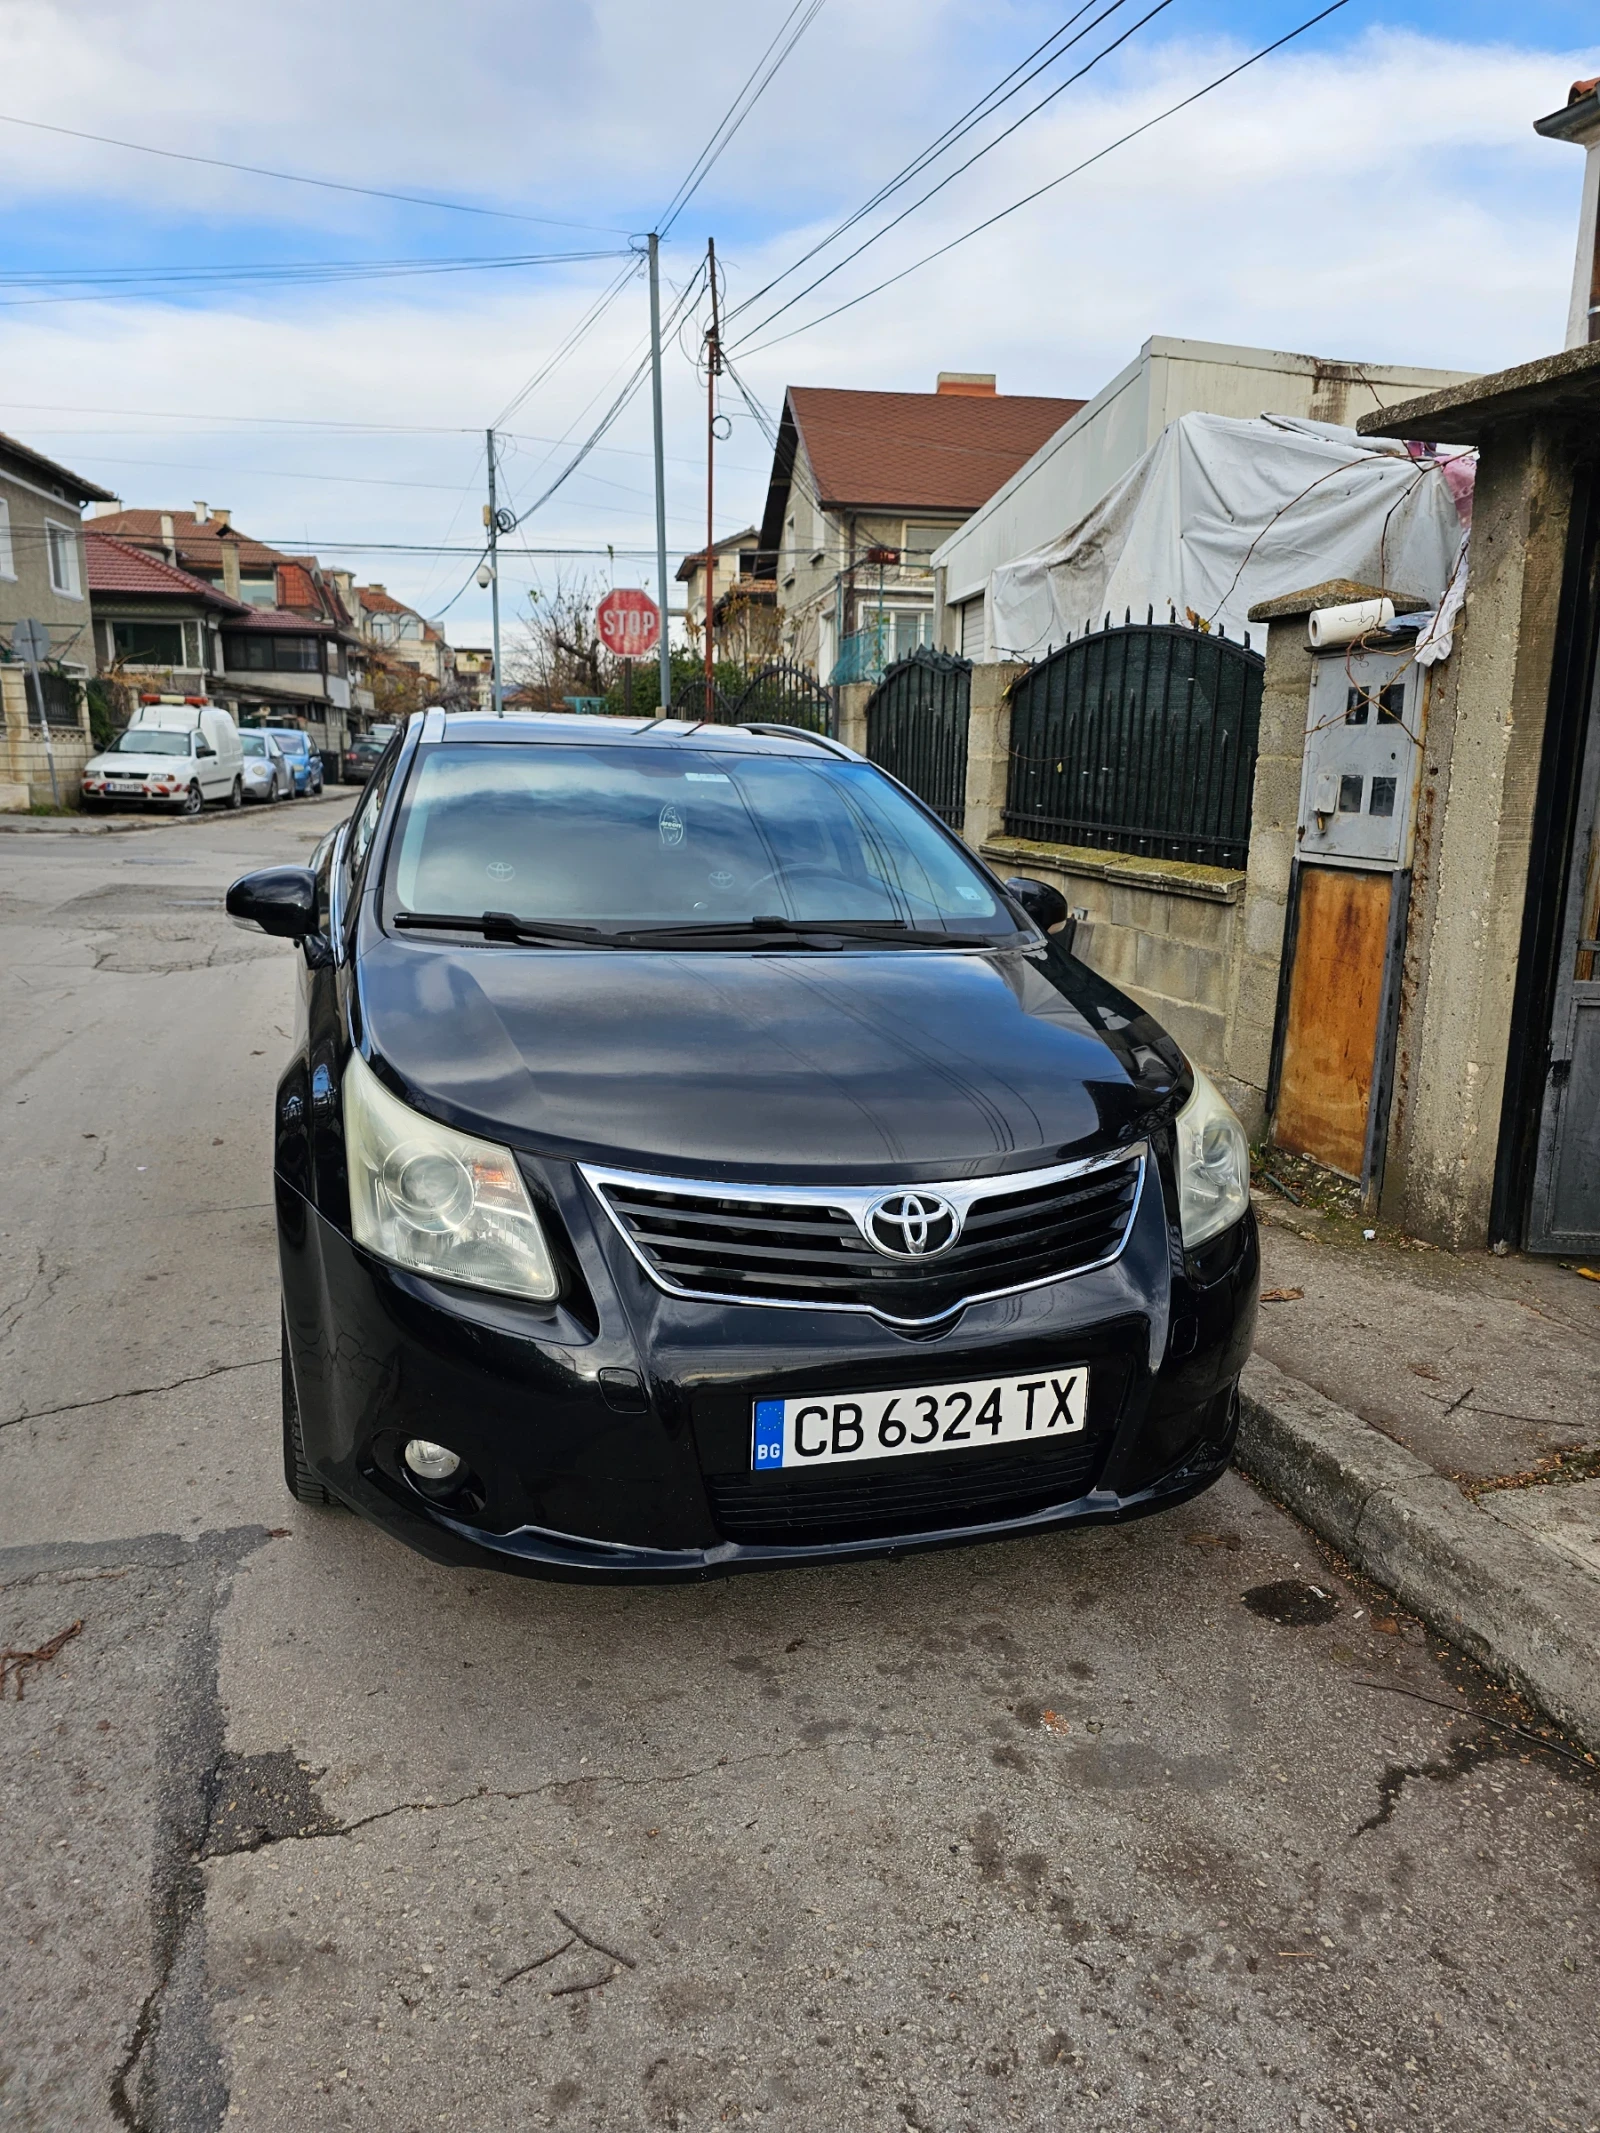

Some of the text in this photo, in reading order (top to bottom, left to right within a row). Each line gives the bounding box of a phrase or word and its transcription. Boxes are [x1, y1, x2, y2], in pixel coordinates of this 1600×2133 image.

[603, 610, 655, 637] STOP
[794, 1376, 1078, 1457] CB 6324 TX
[757, 1443, 781, 1460] BG
